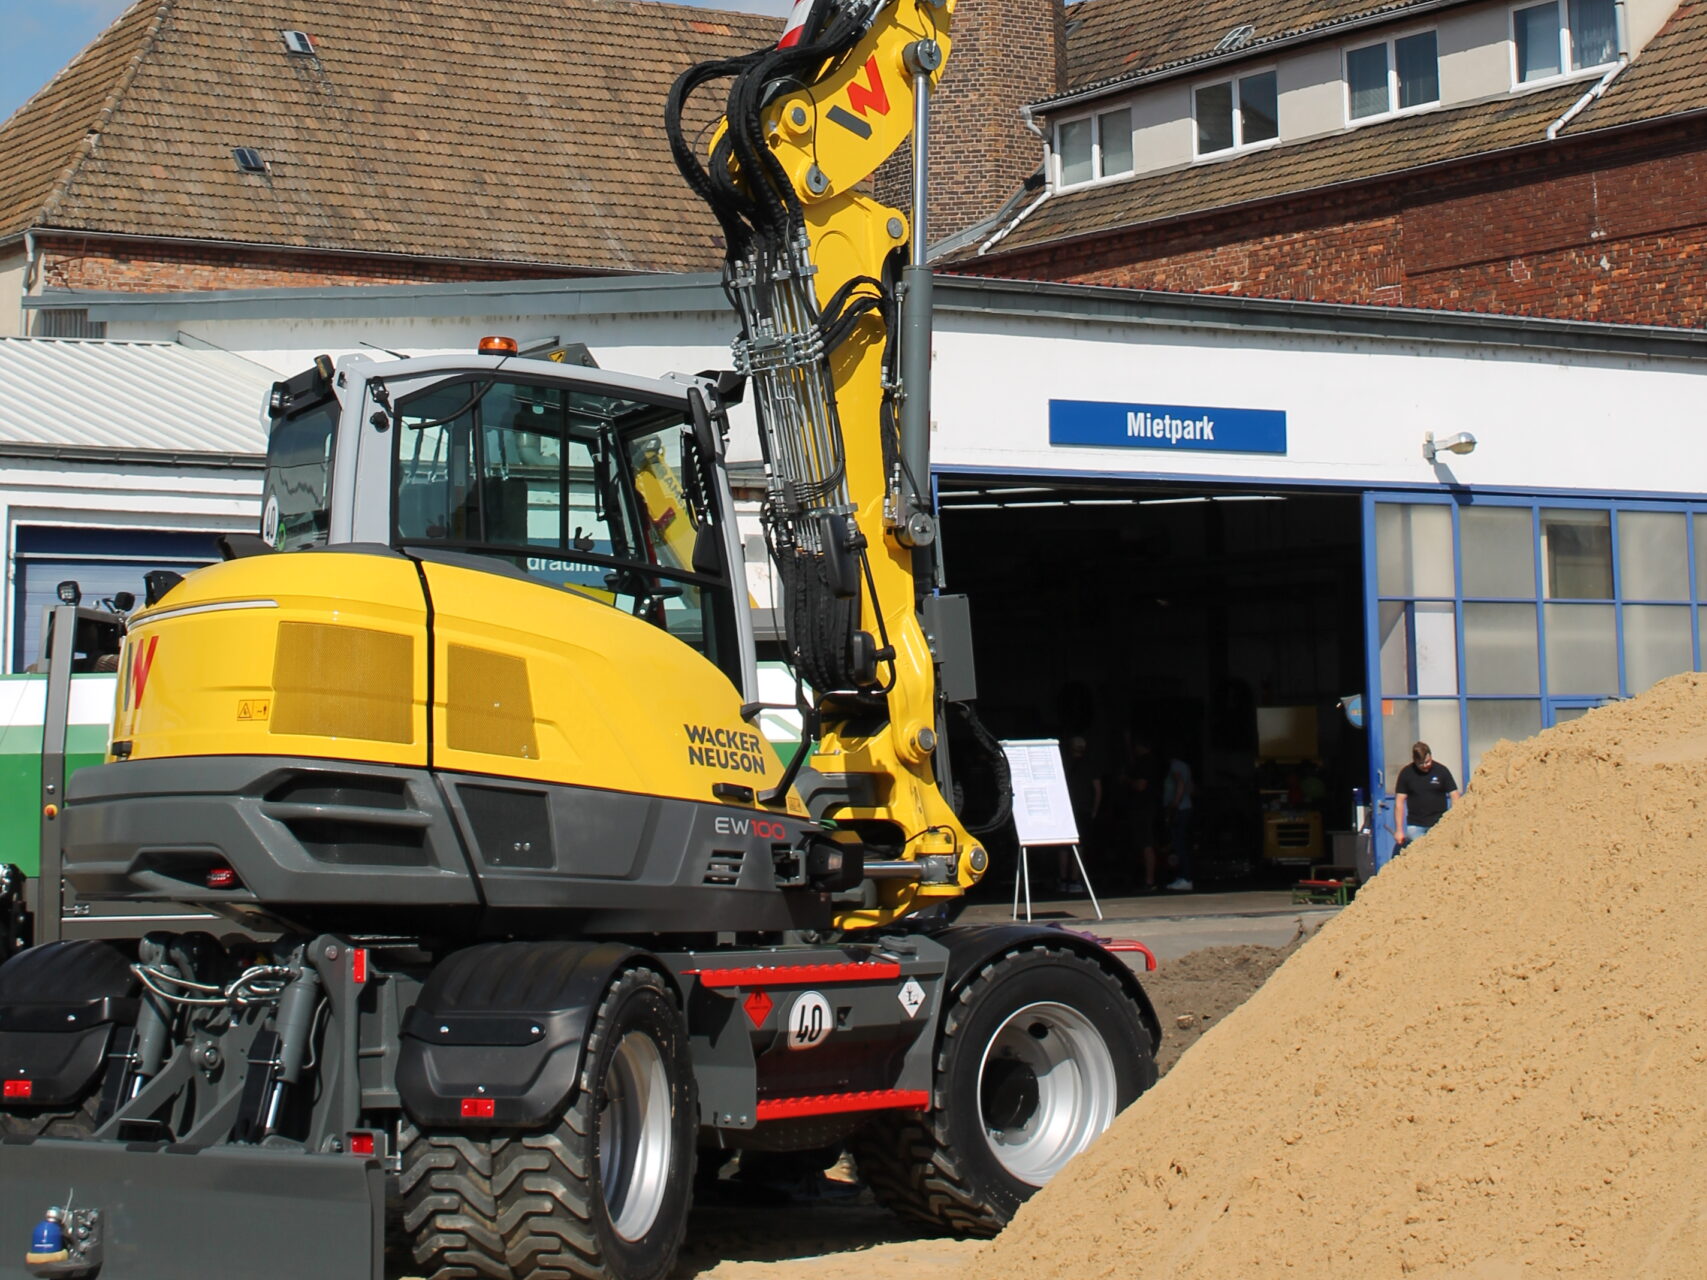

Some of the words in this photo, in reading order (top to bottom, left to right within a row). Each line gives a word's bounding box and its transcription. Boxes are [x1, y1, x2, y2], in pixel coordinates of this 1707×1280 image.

[1127, 412, 1215, 444] Mietpark
[684, 724, 762, 754] WACKER
[688, 746, 765, 775] NEUSON
[715, 817, 785, 840] EW100
[796, 1004, 823, 1043] 40
